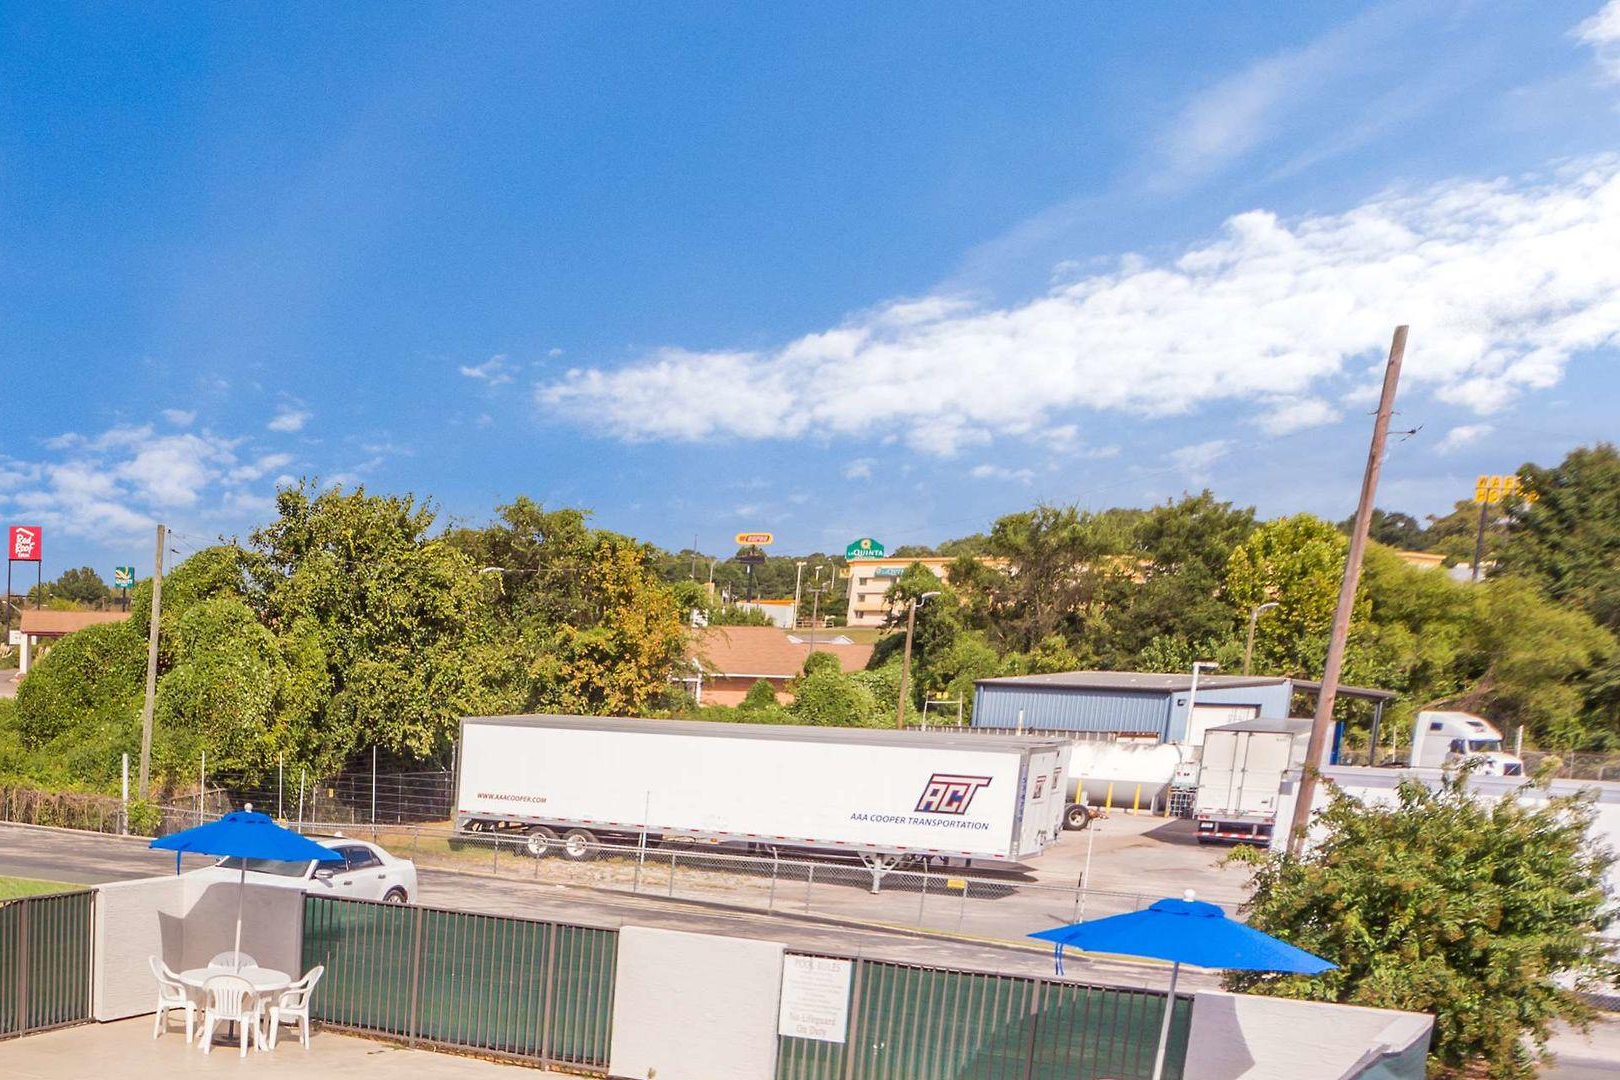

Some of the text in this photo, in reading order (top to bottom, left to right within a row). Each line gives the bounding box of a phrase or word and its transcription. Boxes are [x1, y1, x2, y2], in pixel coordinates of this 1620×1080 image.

[477, 793, 547, 803] WWW.AAACOOPER.COM
[914, 773, 993, 815] ACT
[850, 812, 989, 830] AAA COOPER TRANSPORTATION
